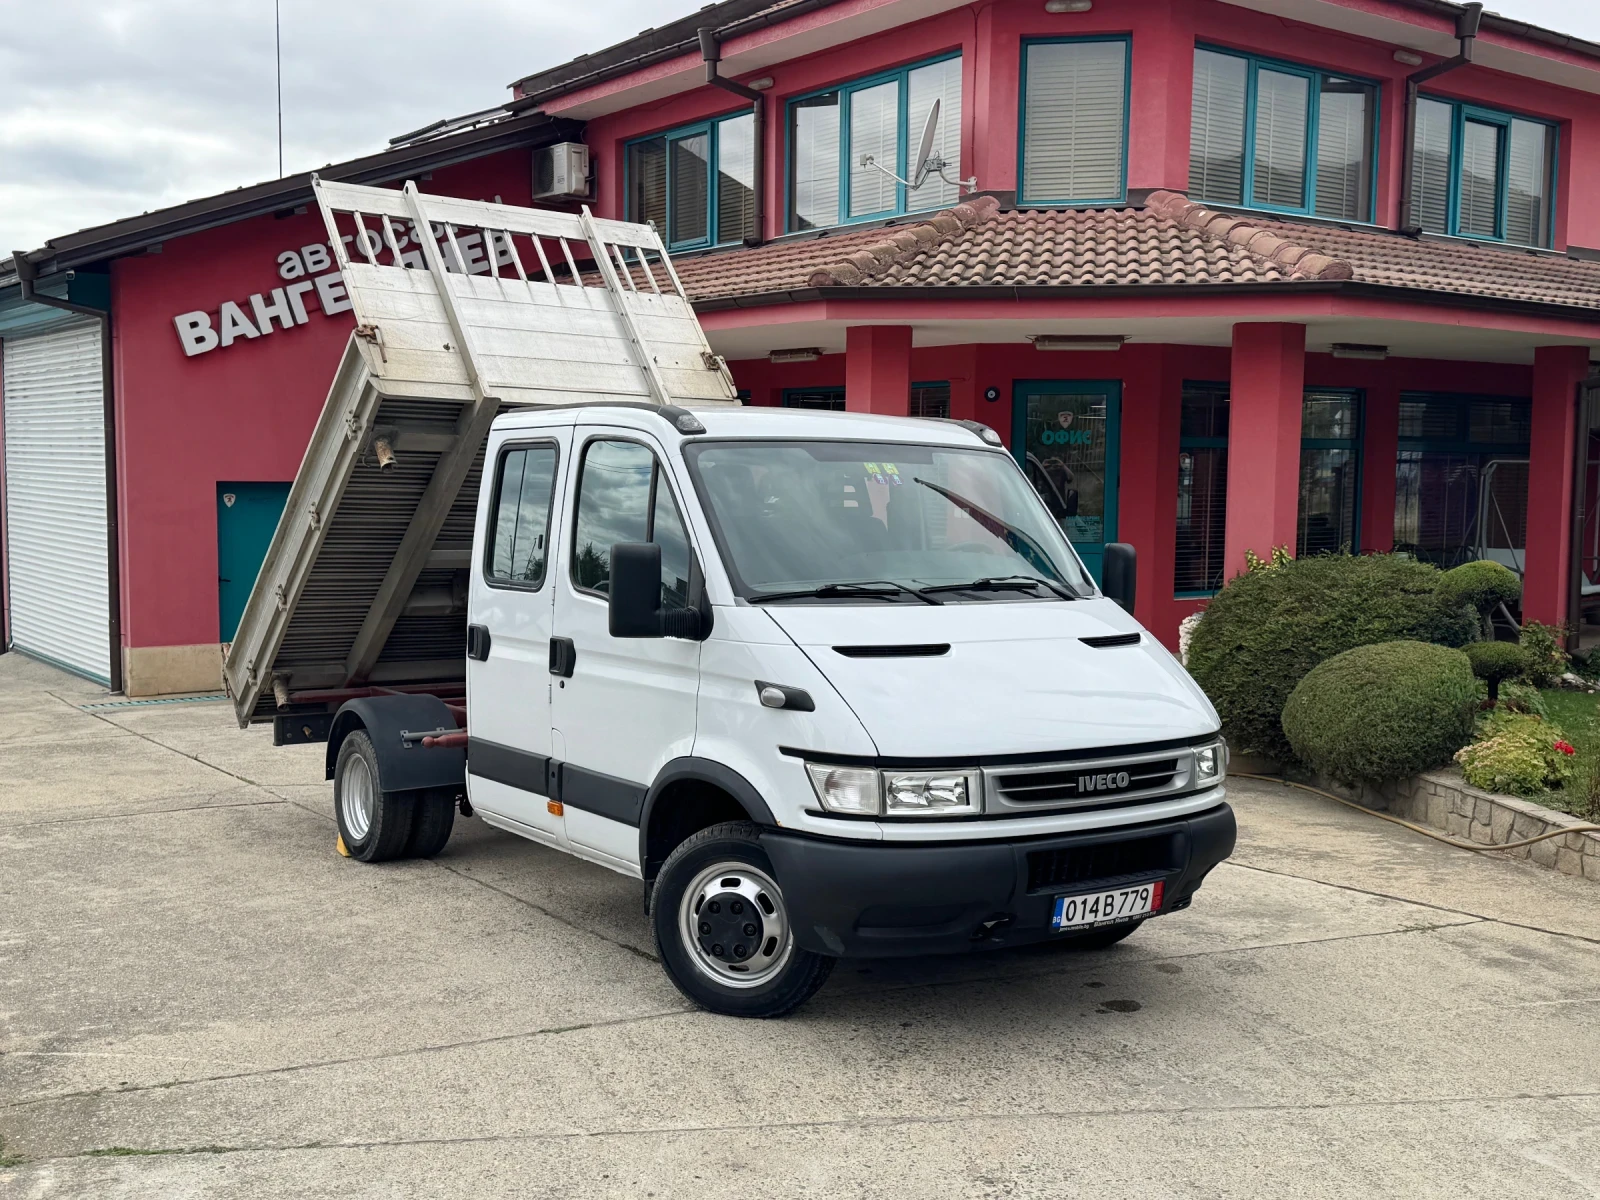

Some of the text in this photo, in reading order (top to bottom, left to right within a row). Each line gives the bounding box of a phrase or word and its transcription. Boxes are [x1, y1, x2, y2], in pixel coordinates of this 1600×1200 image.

[174, 271, 354, 357] ВАНГЕ
[1041, 430, 1092, 445] ОФИС
[1078, 772, 1130, 792] IVECO
